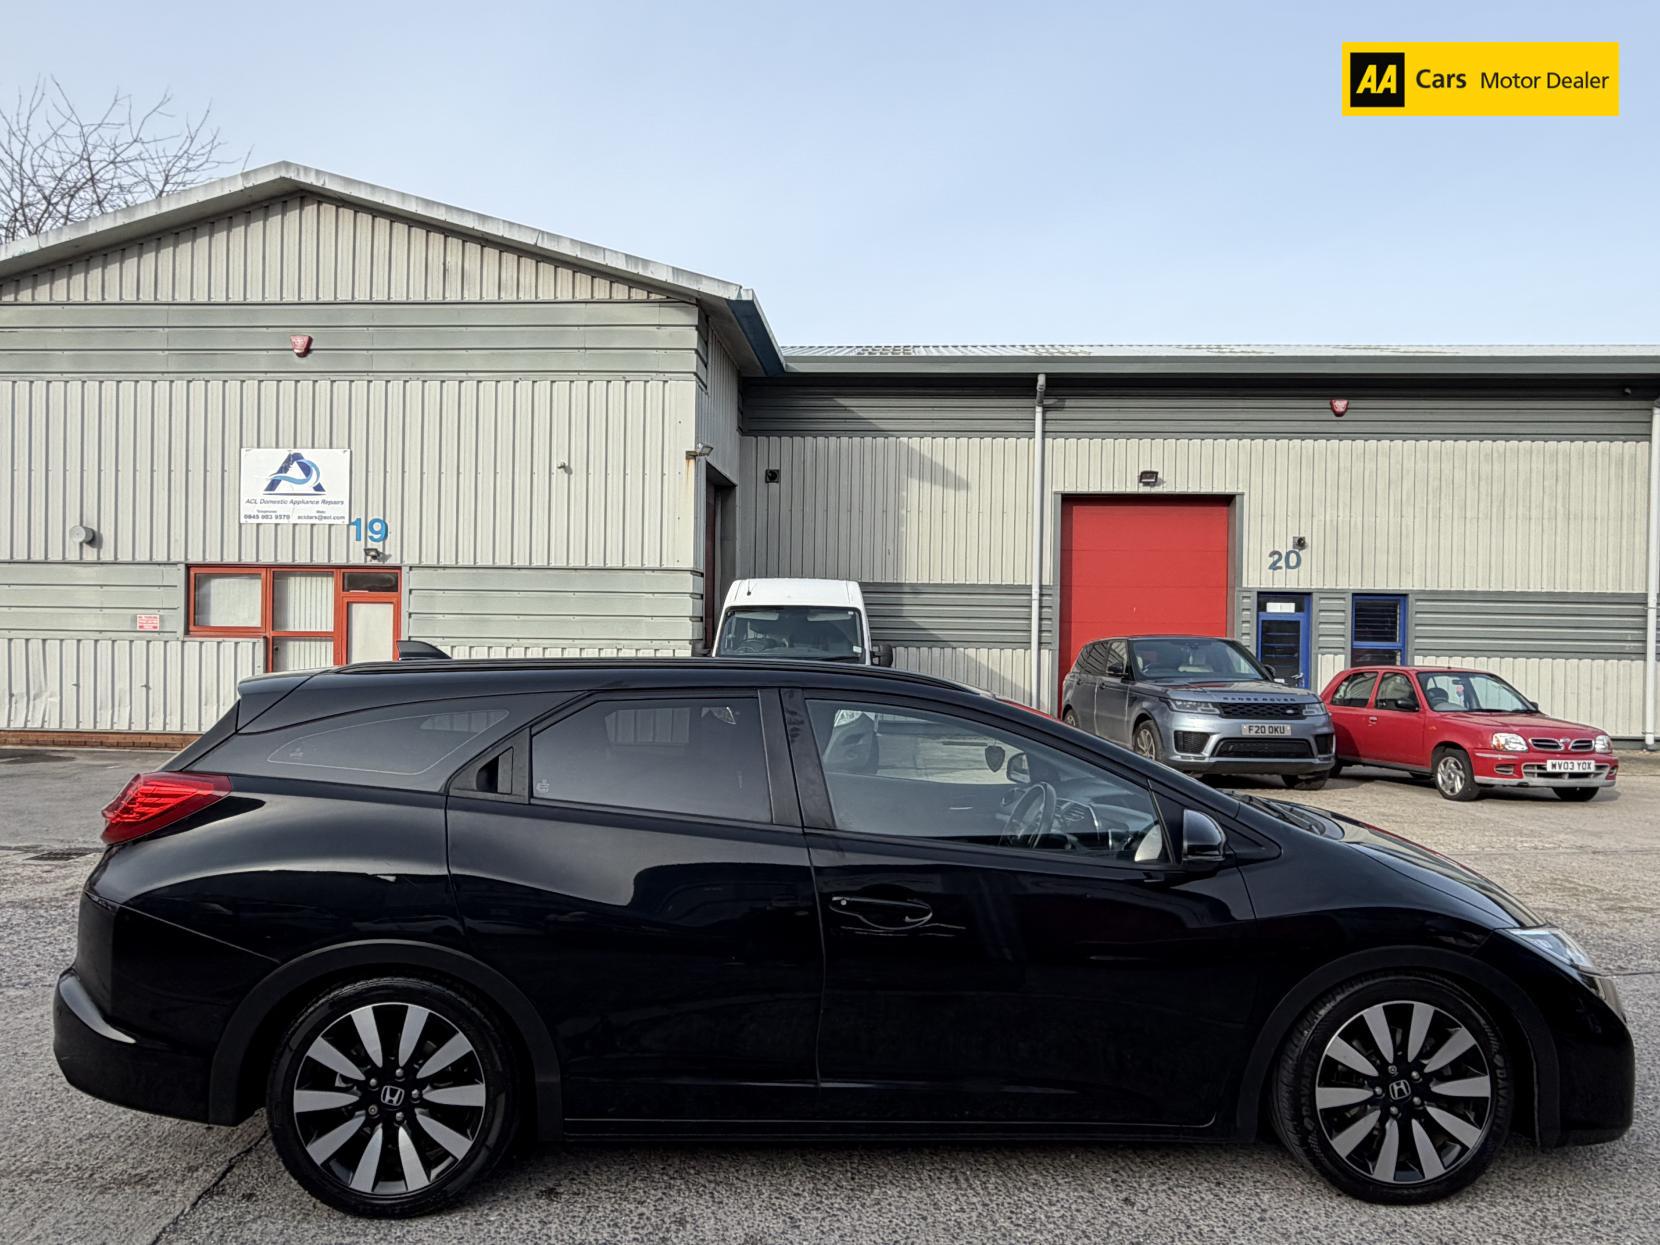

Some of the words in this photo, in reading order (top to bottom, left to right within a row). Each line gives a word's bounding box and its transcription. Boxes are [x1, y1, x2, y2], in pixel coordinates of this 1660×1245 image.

[290, 498, 320, 506] Appliance
[321, 498, 345, 506] Repairs
[350, 517, 389, 543] 19
[1268, 550, 1302, 571] 20
[1248, 725, 1266, 734] F20
